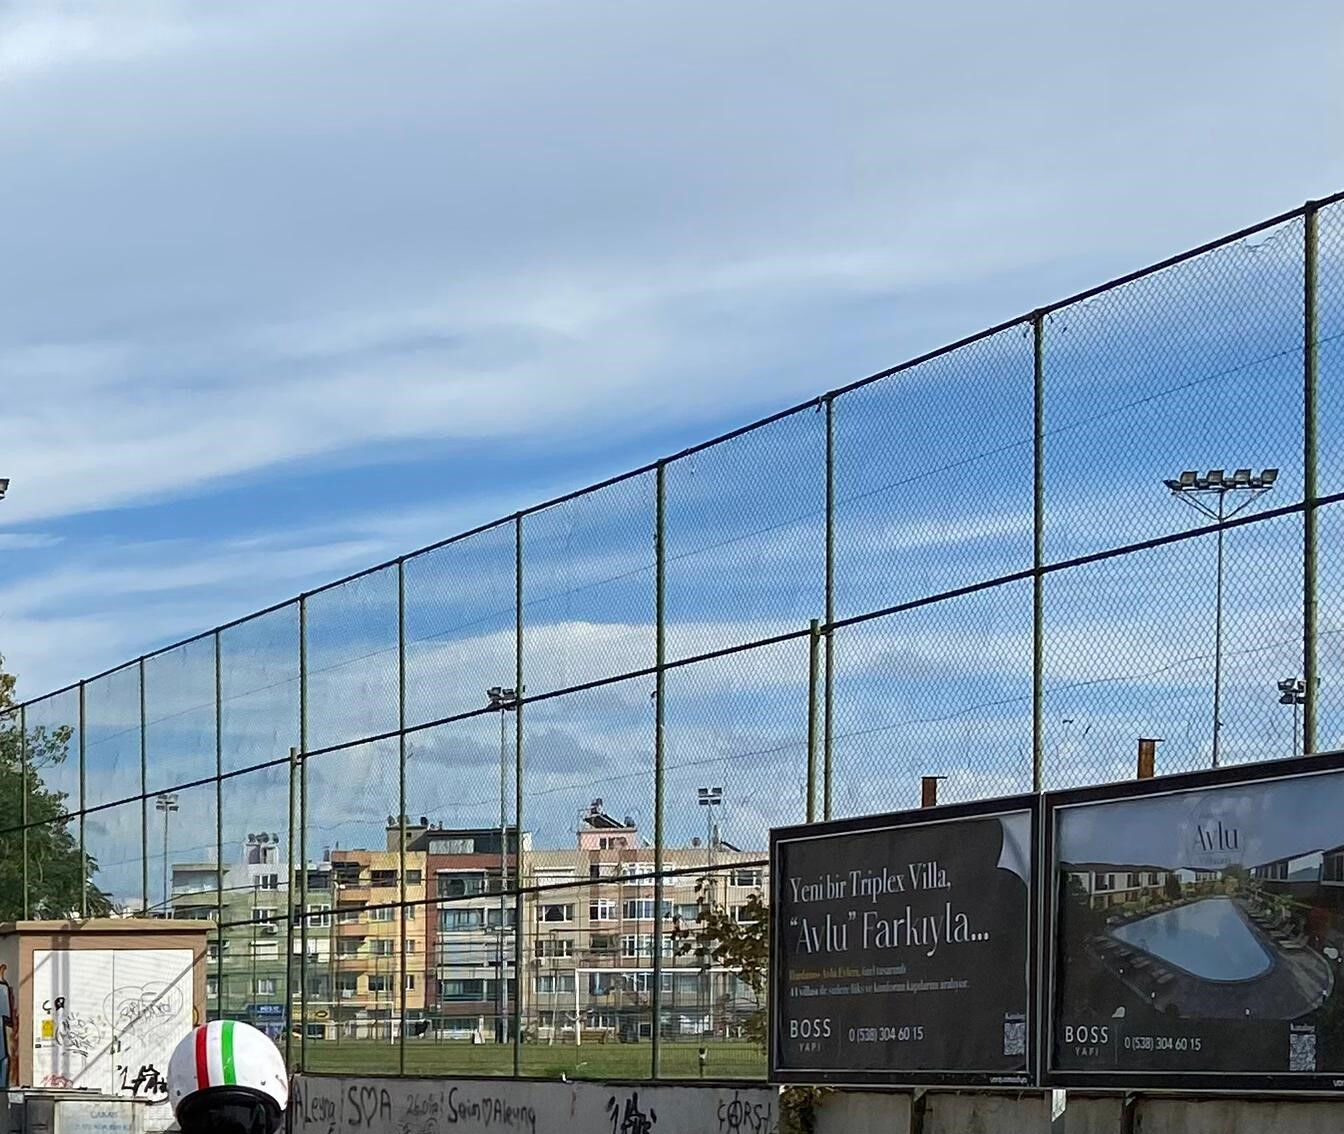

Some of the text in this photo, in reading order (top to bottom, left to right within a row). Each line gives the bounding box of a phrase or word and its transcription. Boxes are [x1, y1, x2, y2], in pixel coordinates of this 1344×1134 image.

[1193, 820, 1239, 851] Avlu
[790, 861, 952, 904] Yeni bir Triplex Villa,
[790, 1018, 832, 1039] BOSS
[879, 1027, 896, 1042] 304
[897, 1026, 911, 1041] 60
[912, 1026, 924, 1041] 15
[1065, 1026, 1109, 1044] BOSS
[1132, 1037, 1154, 1050] (538)
[1156, 1037, 1173, 1050] 304
[1175, 1037, 1188, 1050] 60
[1190, 1037, 1201, 1051] 15
